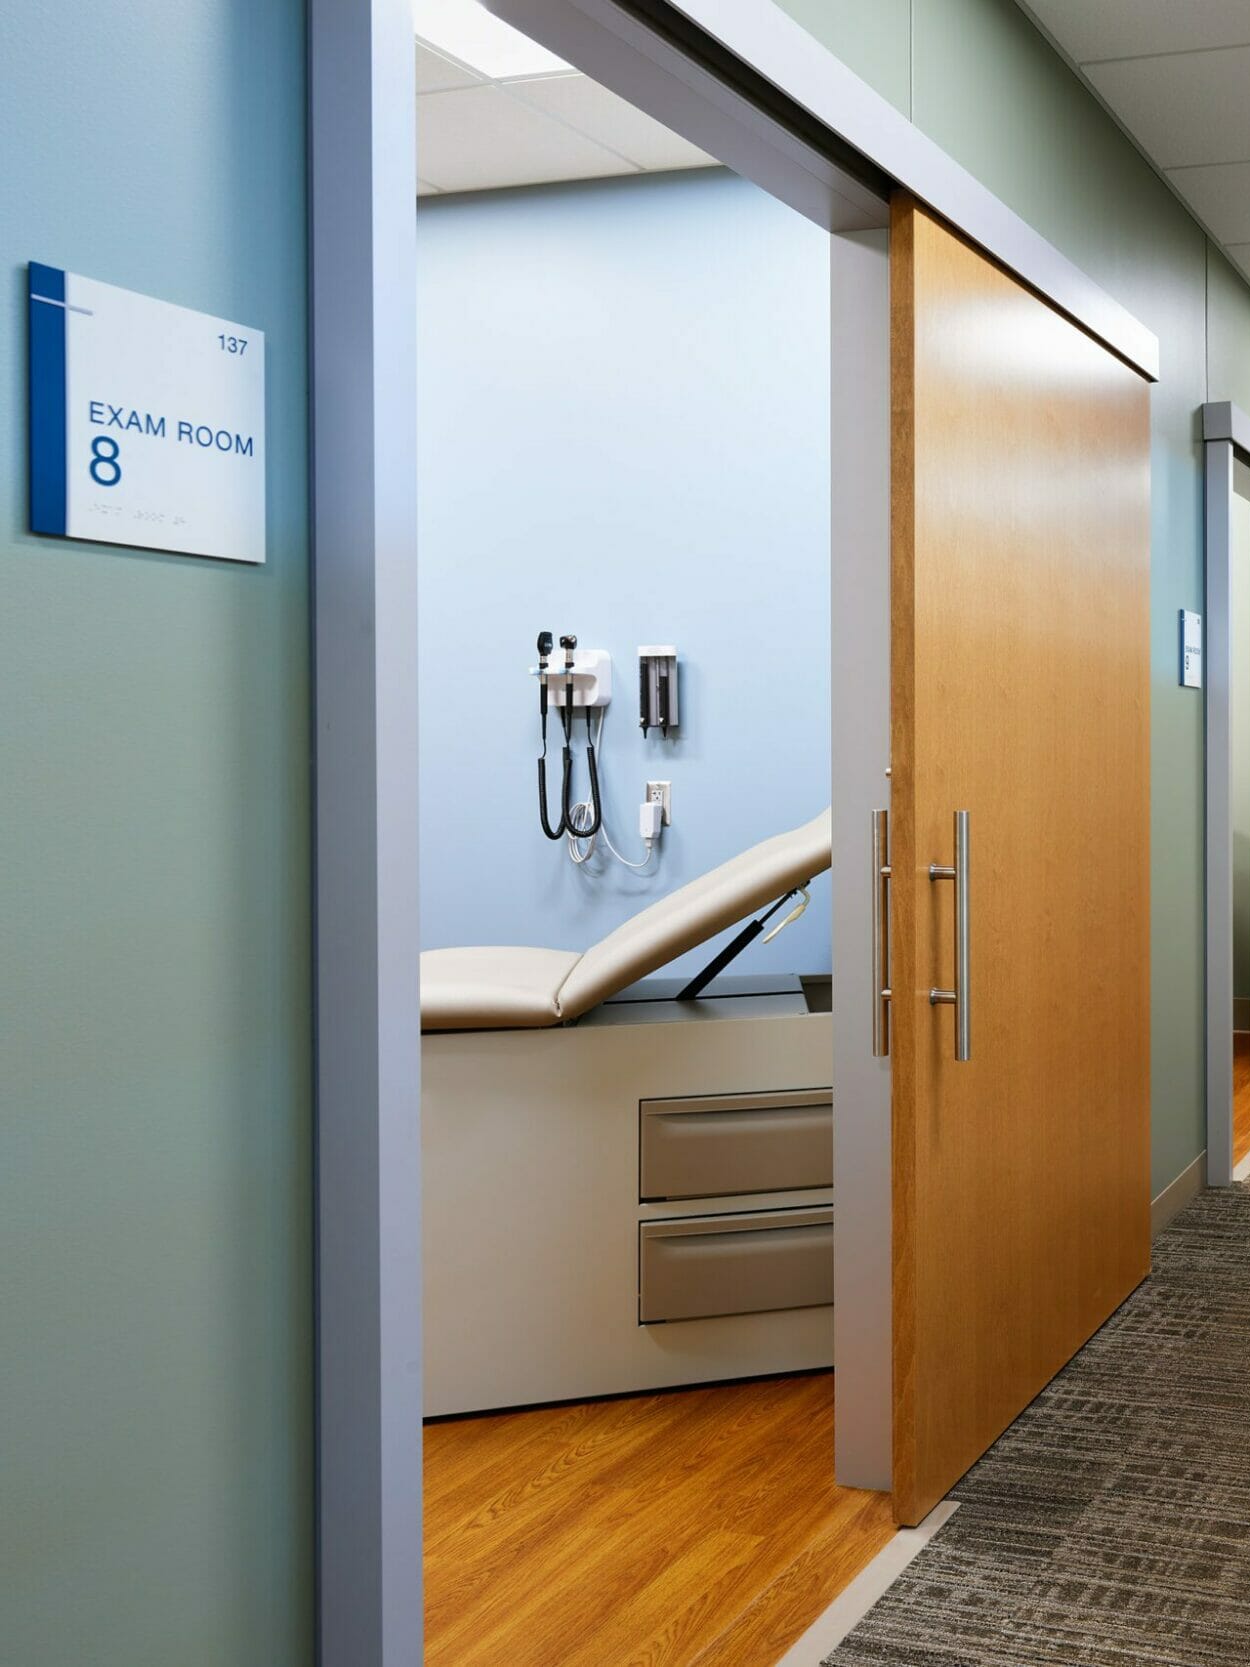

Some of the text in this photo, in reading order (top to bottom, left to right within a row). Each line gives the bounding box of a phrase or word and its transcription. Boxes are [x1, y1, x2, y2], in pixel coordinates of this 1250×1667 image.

[218, 334, 248, 355] 137
[89, 400, 253, 457] EXAM ROOM
[89, 435, 122, 487] 8
